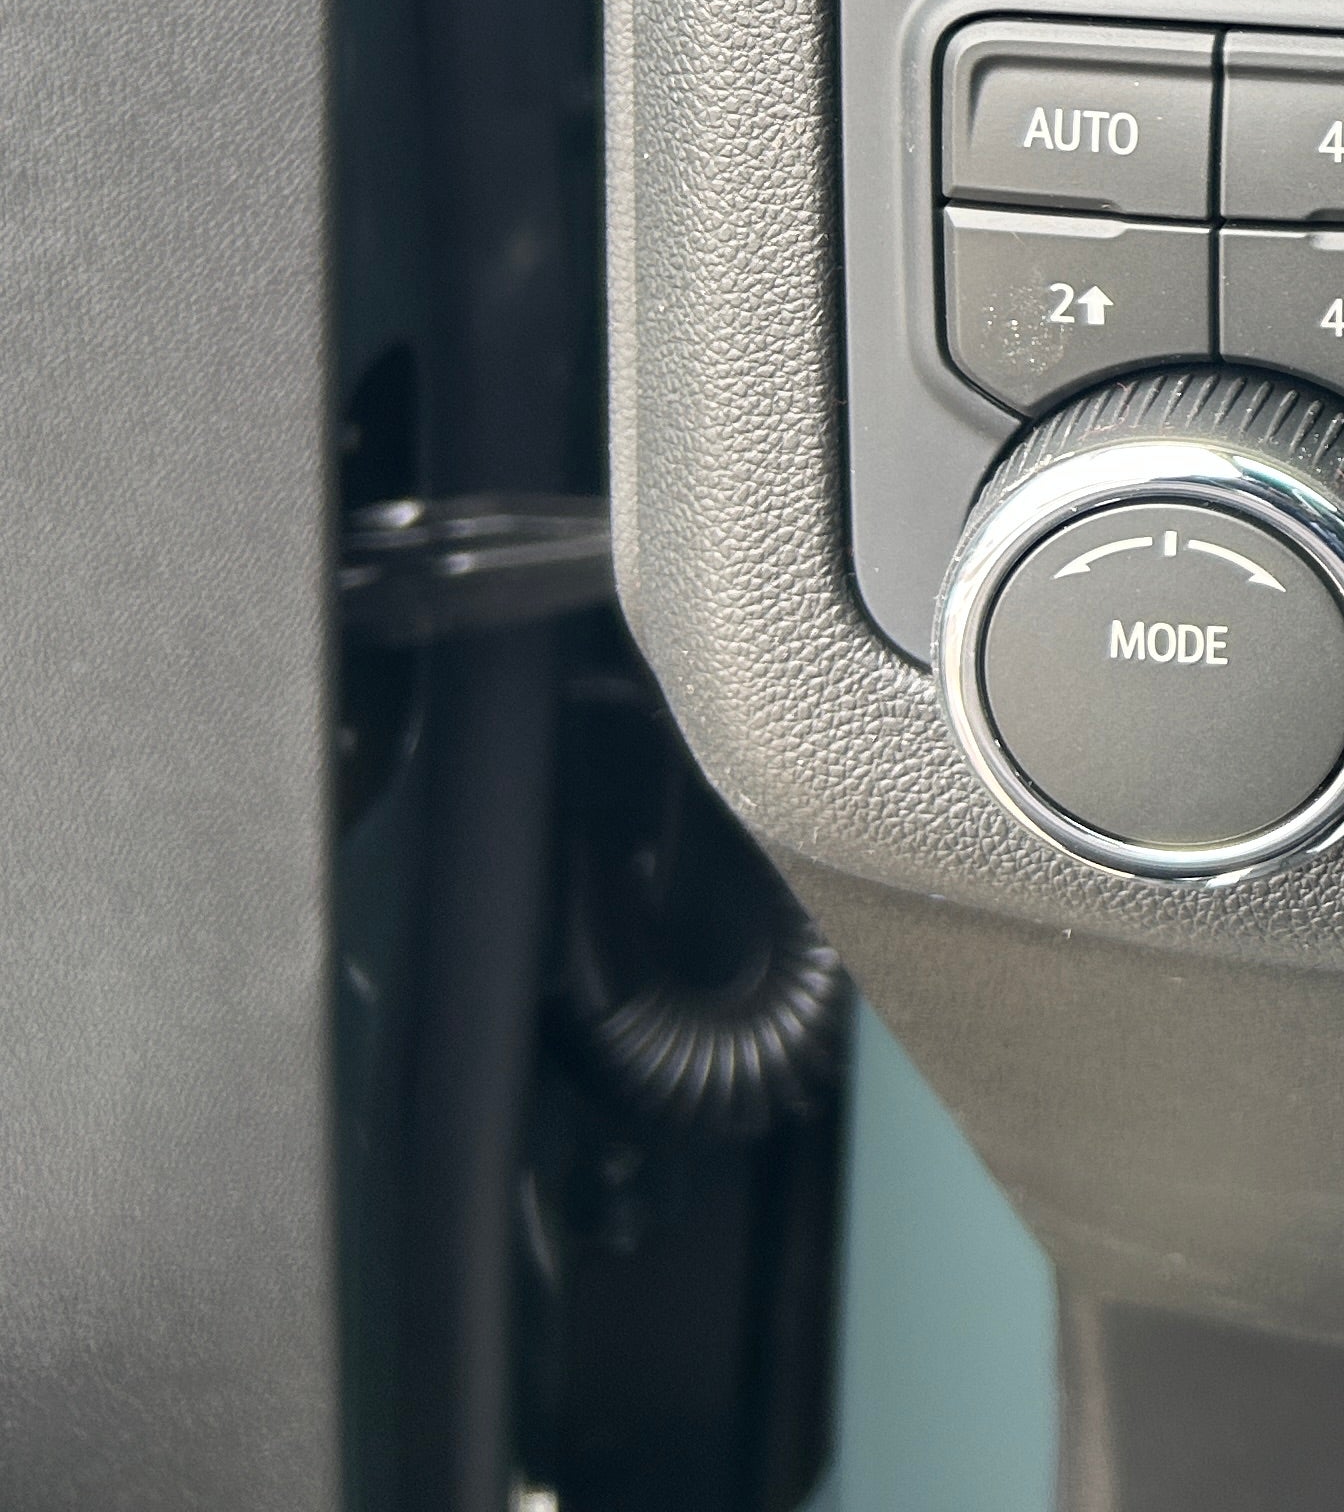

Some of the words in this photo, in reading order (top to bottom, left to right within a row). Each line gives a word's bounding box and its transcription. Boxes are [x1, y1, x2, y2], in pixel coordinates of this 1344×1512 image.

[1023, 107, 1139, 156] AUTO
[1050, 283, 1075, 324] 2
[1109, 619, 1229, 666] MODE
